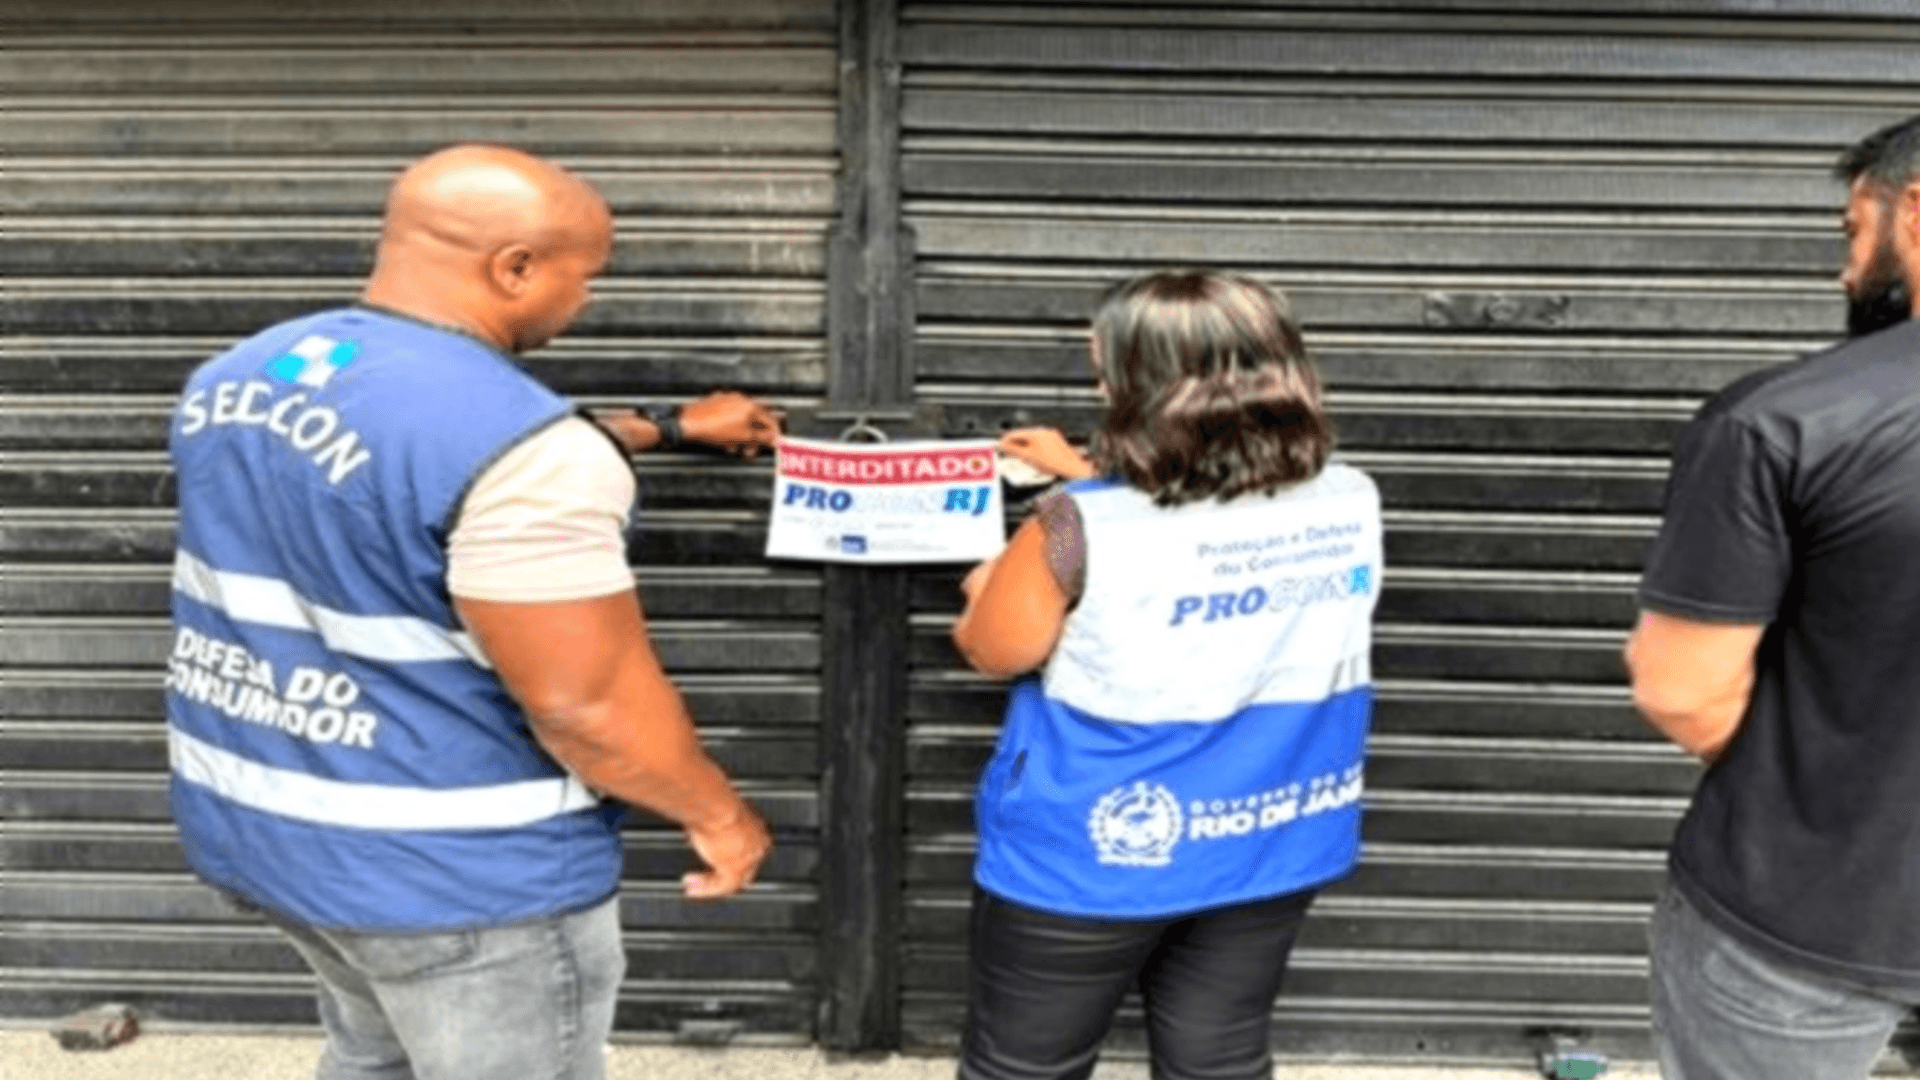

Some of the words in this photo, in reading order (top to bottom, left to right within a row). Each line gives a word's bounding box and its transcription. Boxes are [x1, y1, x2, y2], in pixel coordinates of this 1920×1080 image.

[181, 380, 371, 484] SECCON
[780, 454, 990, 481] INTERDITADO
[285, 667, 360, 707] DO
[1189, 811, 1255, 841] RIO
[1258, 799, 1298, 829] DE
